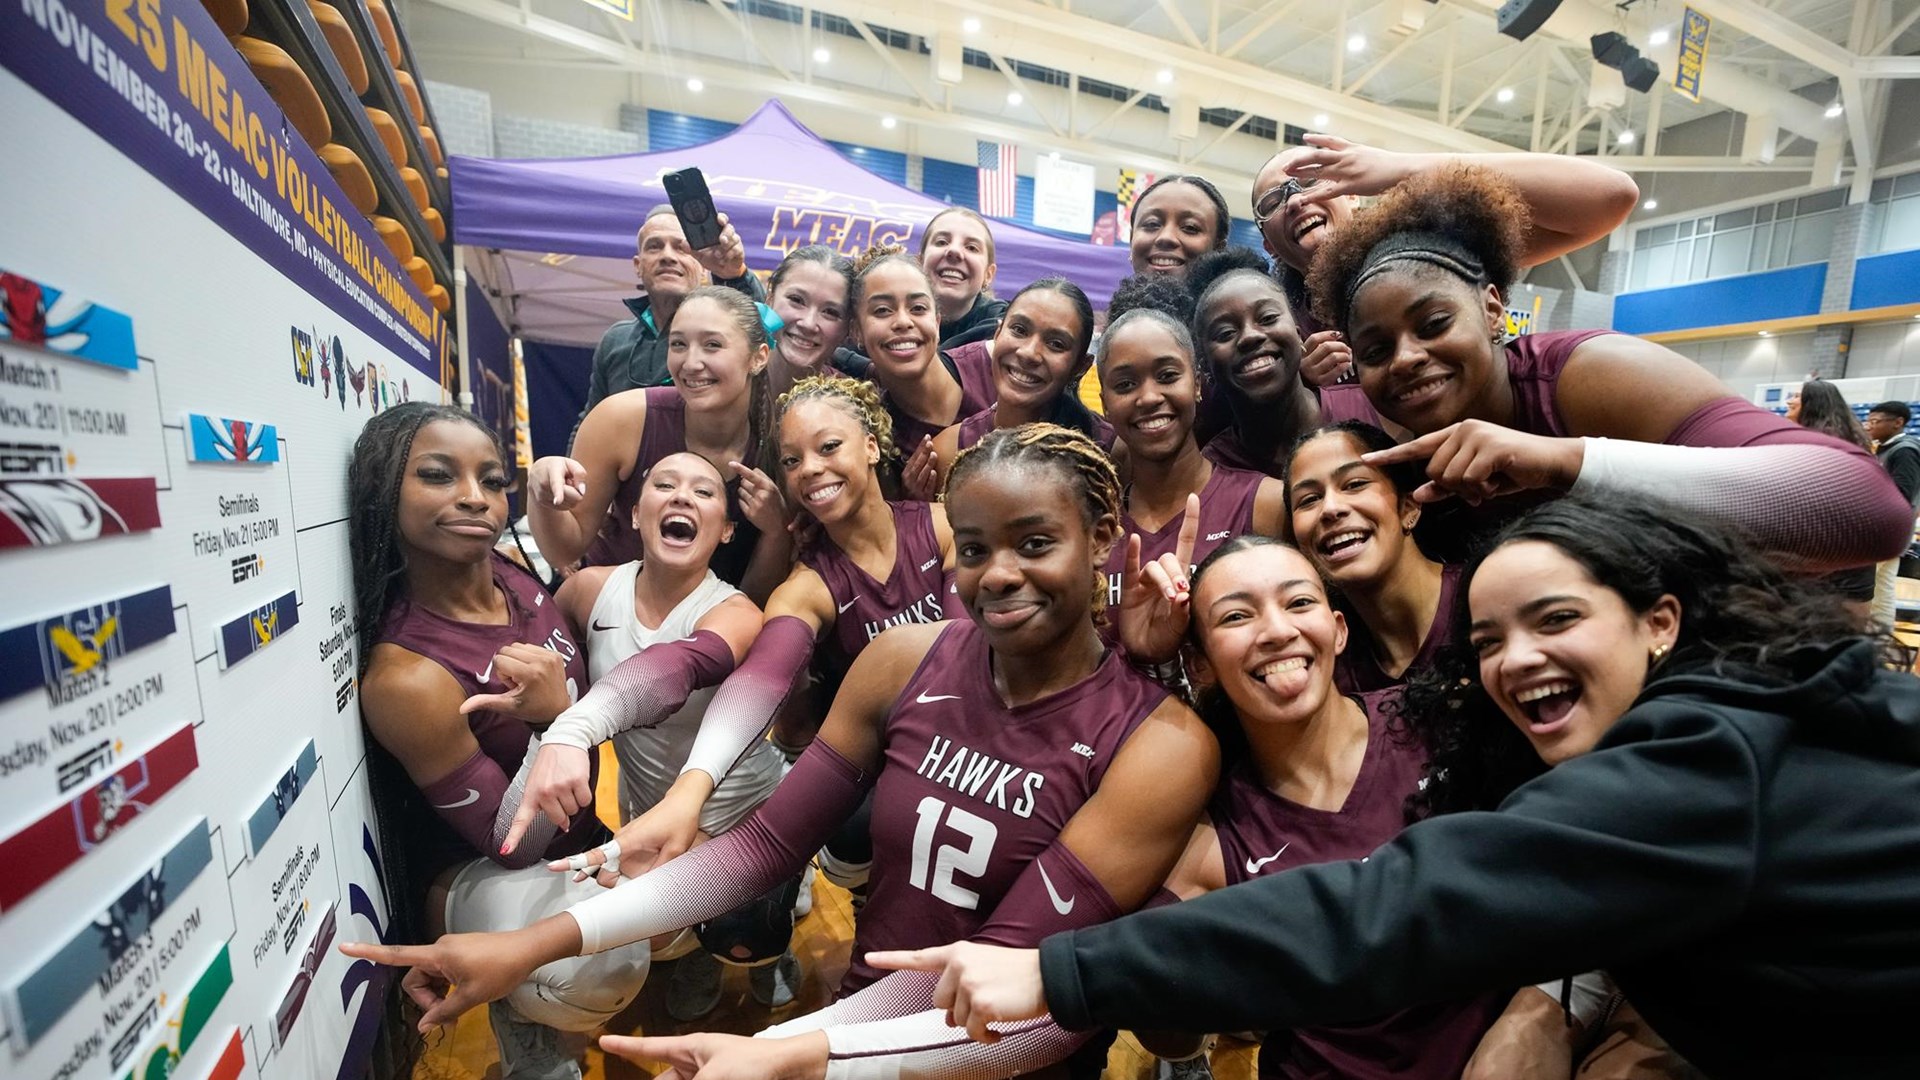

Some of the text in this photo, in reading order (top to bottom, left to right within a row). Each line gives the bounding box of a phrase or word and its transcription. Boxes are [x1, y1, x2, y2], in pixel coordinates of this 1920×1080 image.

[21, 0, 173, 139] NOVEMBER
[172, 112, 222, 183] 20-22
[230, 167, 294, 252] BALTIMORE,
[293, 227, 308, 258] MD
[312, 245, 347, 292] PHYSICAL
[172, 15, 270, 180] MEAC
[270, 133, 374, 287] VOLLEYBALL
[765, 207, 914, 258] MEAC
[104, 411, 128, 437] AM
[218, 492, 260, 518] Semifinals
[193, 530, 225, 558] Friday,
[222, 526, 241, 550] Nov.
[240, 523, 250, 546] 21
[252, 519, 269, 542] 5:00
[268, 517, 280, 538] PM
[330, 601, 347, 627] Finals
[99, 662, 110, 687] 2
[333, 647, 354, 683] 5:00 PM
[49, 720, 86, 749] Nov.
[86, 703, 107, 732] 20
[114, 684, 143, 717] 2:00
[143, 673, 165, 702] PM
[916, 734, 1045, 819] HAWKS
[271, 844, 304, 903] Semifinals
[909, 796, 998, 910] 12
[253, 922, 278, 969] Friday,
[275, 899, 291, 930] Nov.
[289, 882, 298, 907] 21
[310, 842, 321, 871] PM
[103, 992, 134, 1034] Nov.
[133, 966, 152, 999] 20
[157, 929, 184, 970] 5:00
[183, 907, 202, 940] PM
